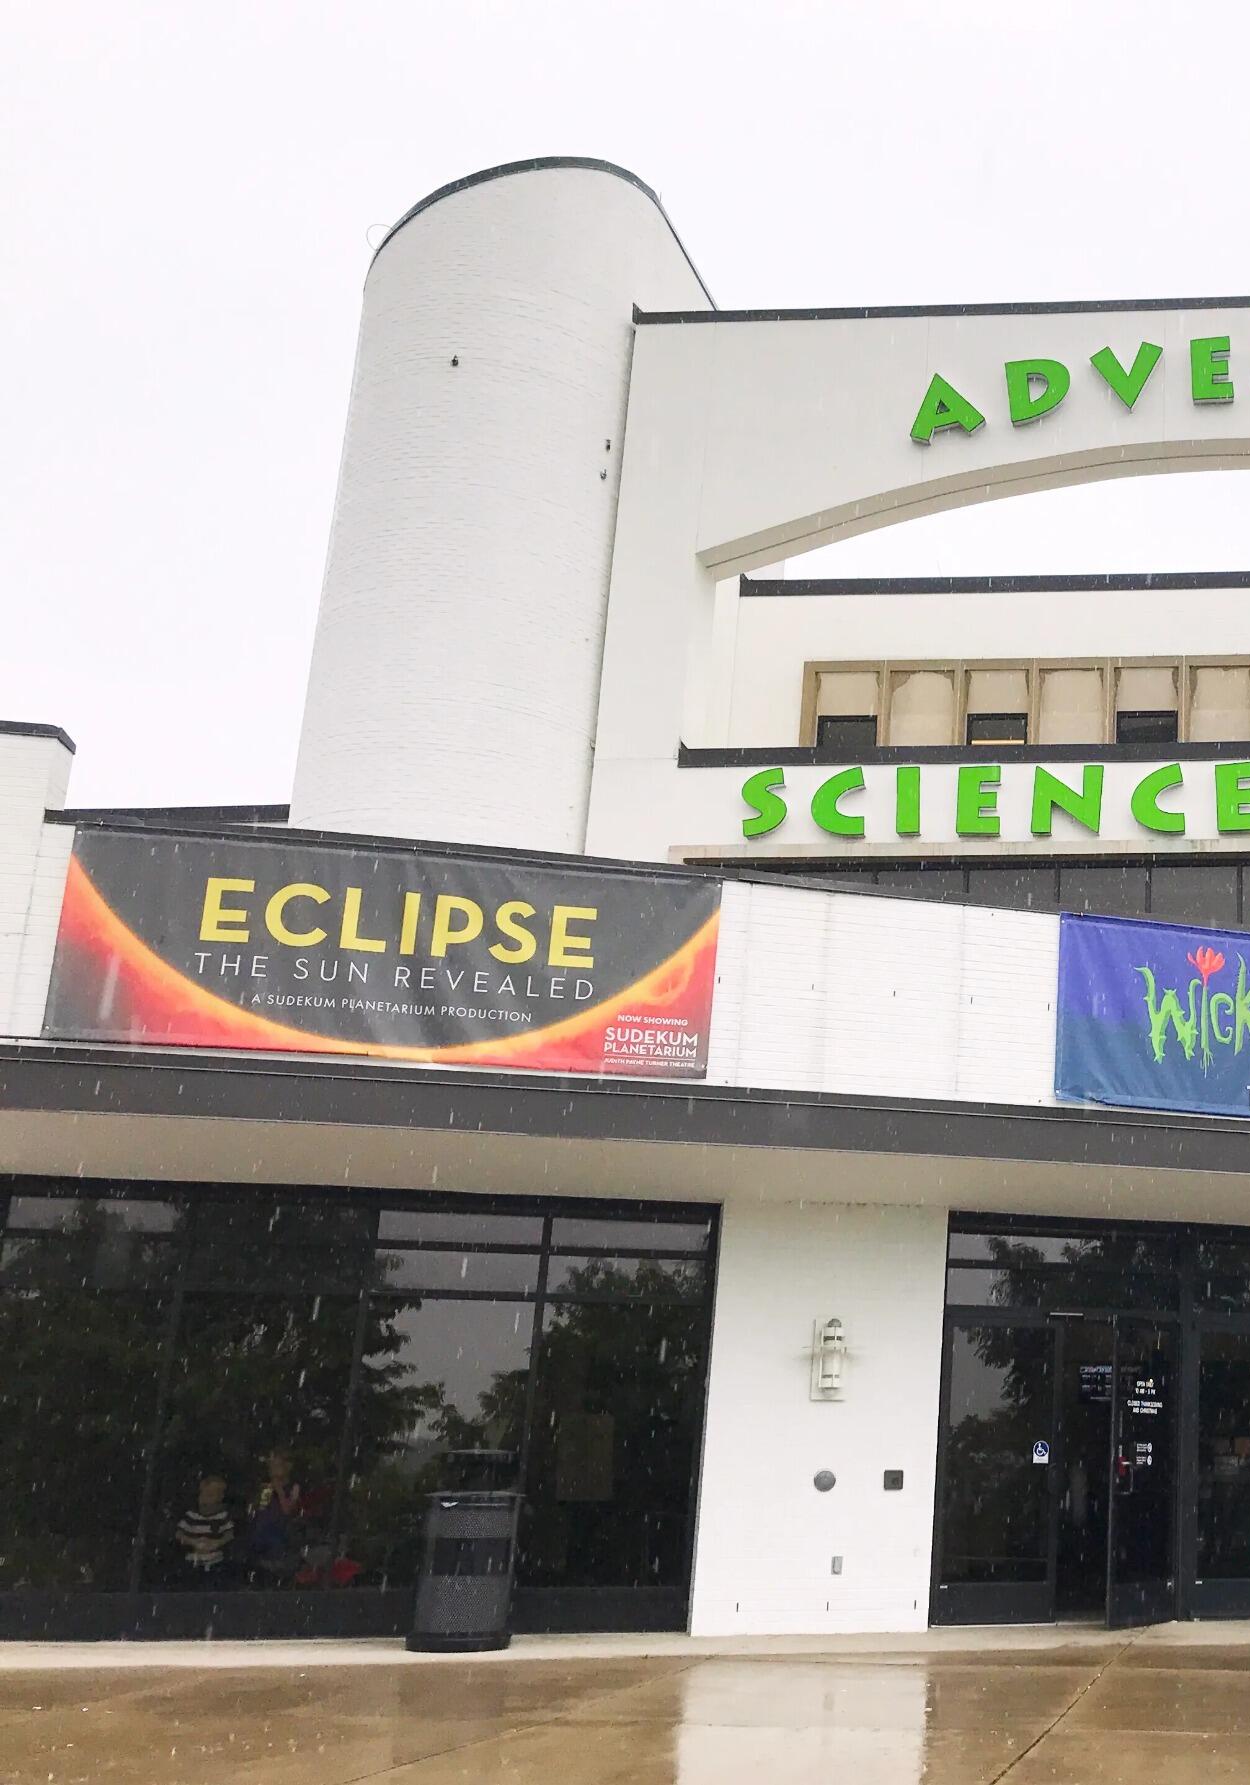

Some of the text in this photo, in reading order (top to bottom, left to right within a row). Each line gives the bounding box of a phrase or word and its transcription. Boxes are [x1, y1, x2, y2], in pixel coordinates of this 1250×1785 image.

[199, 876, 598, 969] ECLIPSE
[194, 952, 594, 1000] THE SUN REVEALED
[250, 993, 532, 1023] A SUDEKUM PLANETARIUM PRODUCTION
[617, 1014, 689, 1027] NOW SHOWING
[604, 1026, 698, 1047] SUDEKUM
[603, 1041, 697, 1058] PLANETARIUM
